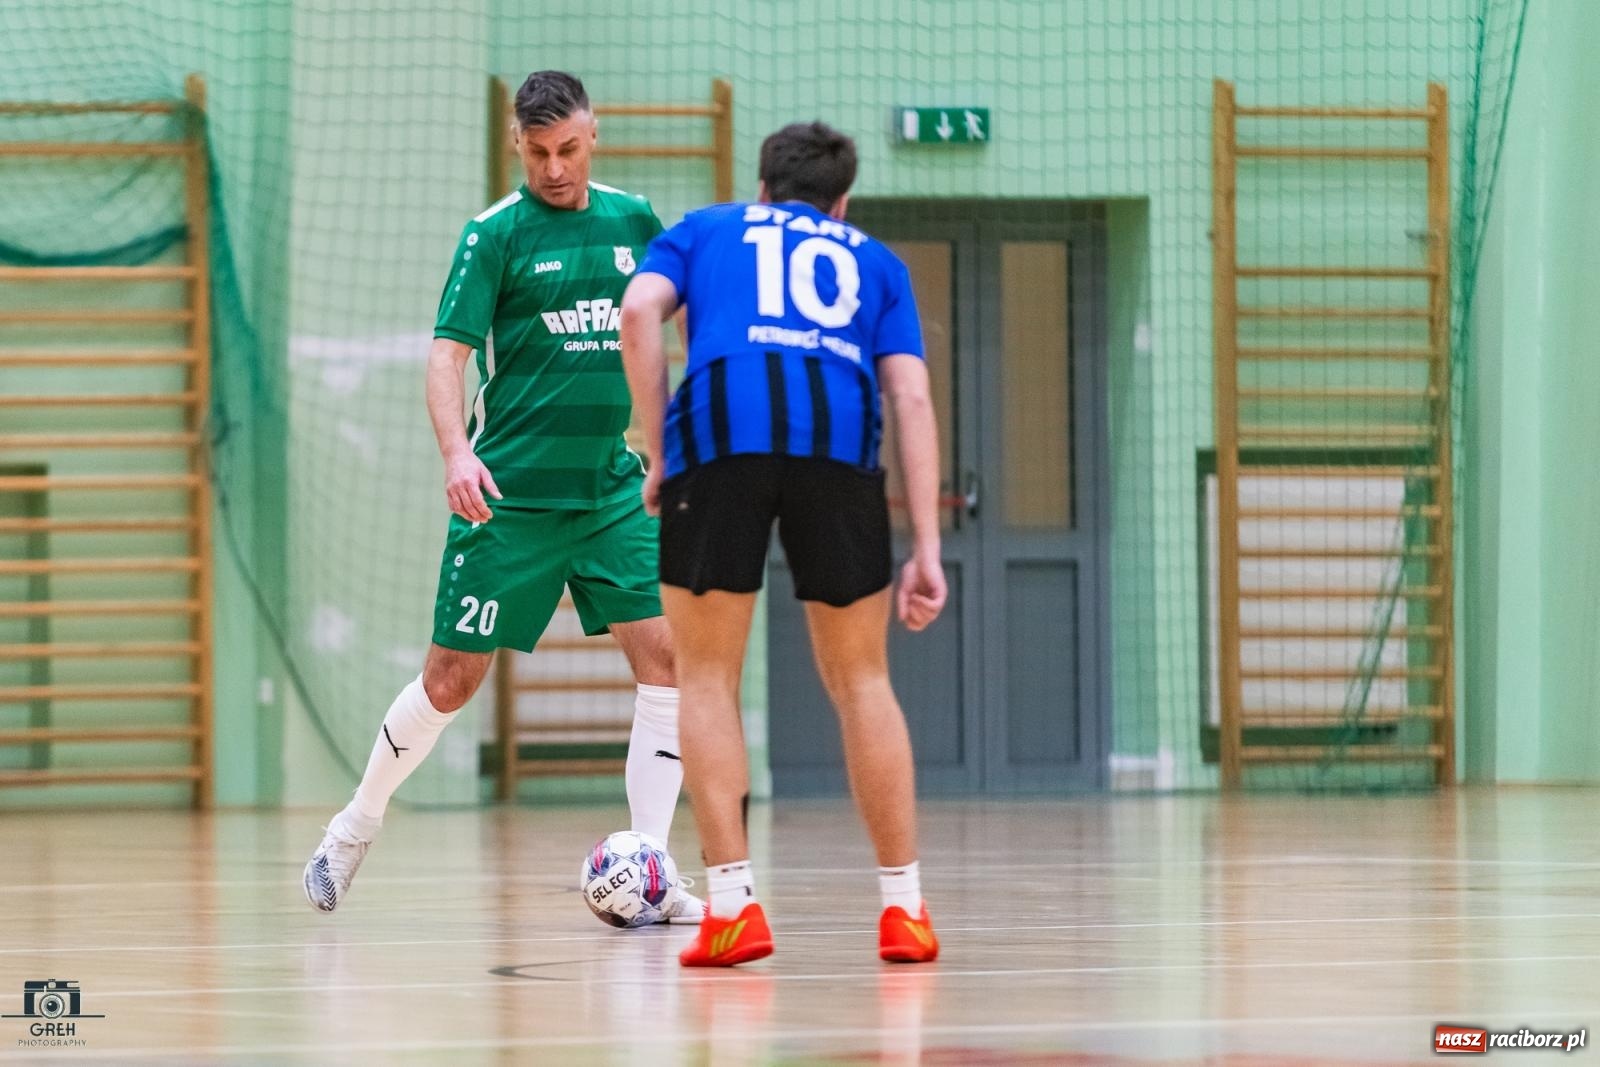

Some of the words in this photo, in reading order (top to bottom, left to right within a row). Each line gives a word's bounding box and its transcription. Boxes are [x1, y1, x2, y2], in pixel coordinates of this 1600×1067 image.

[743, 205, 869, 247] START
[534, 260, 563, 274] JAKO
[742, 225, 861, 329] 10
[563, 340, 600, 352] GRUPA
[602, 340, 623, 351] PBG
[455, 595, 499, 637] 20
[592, 867, 633, 904] SELECT
